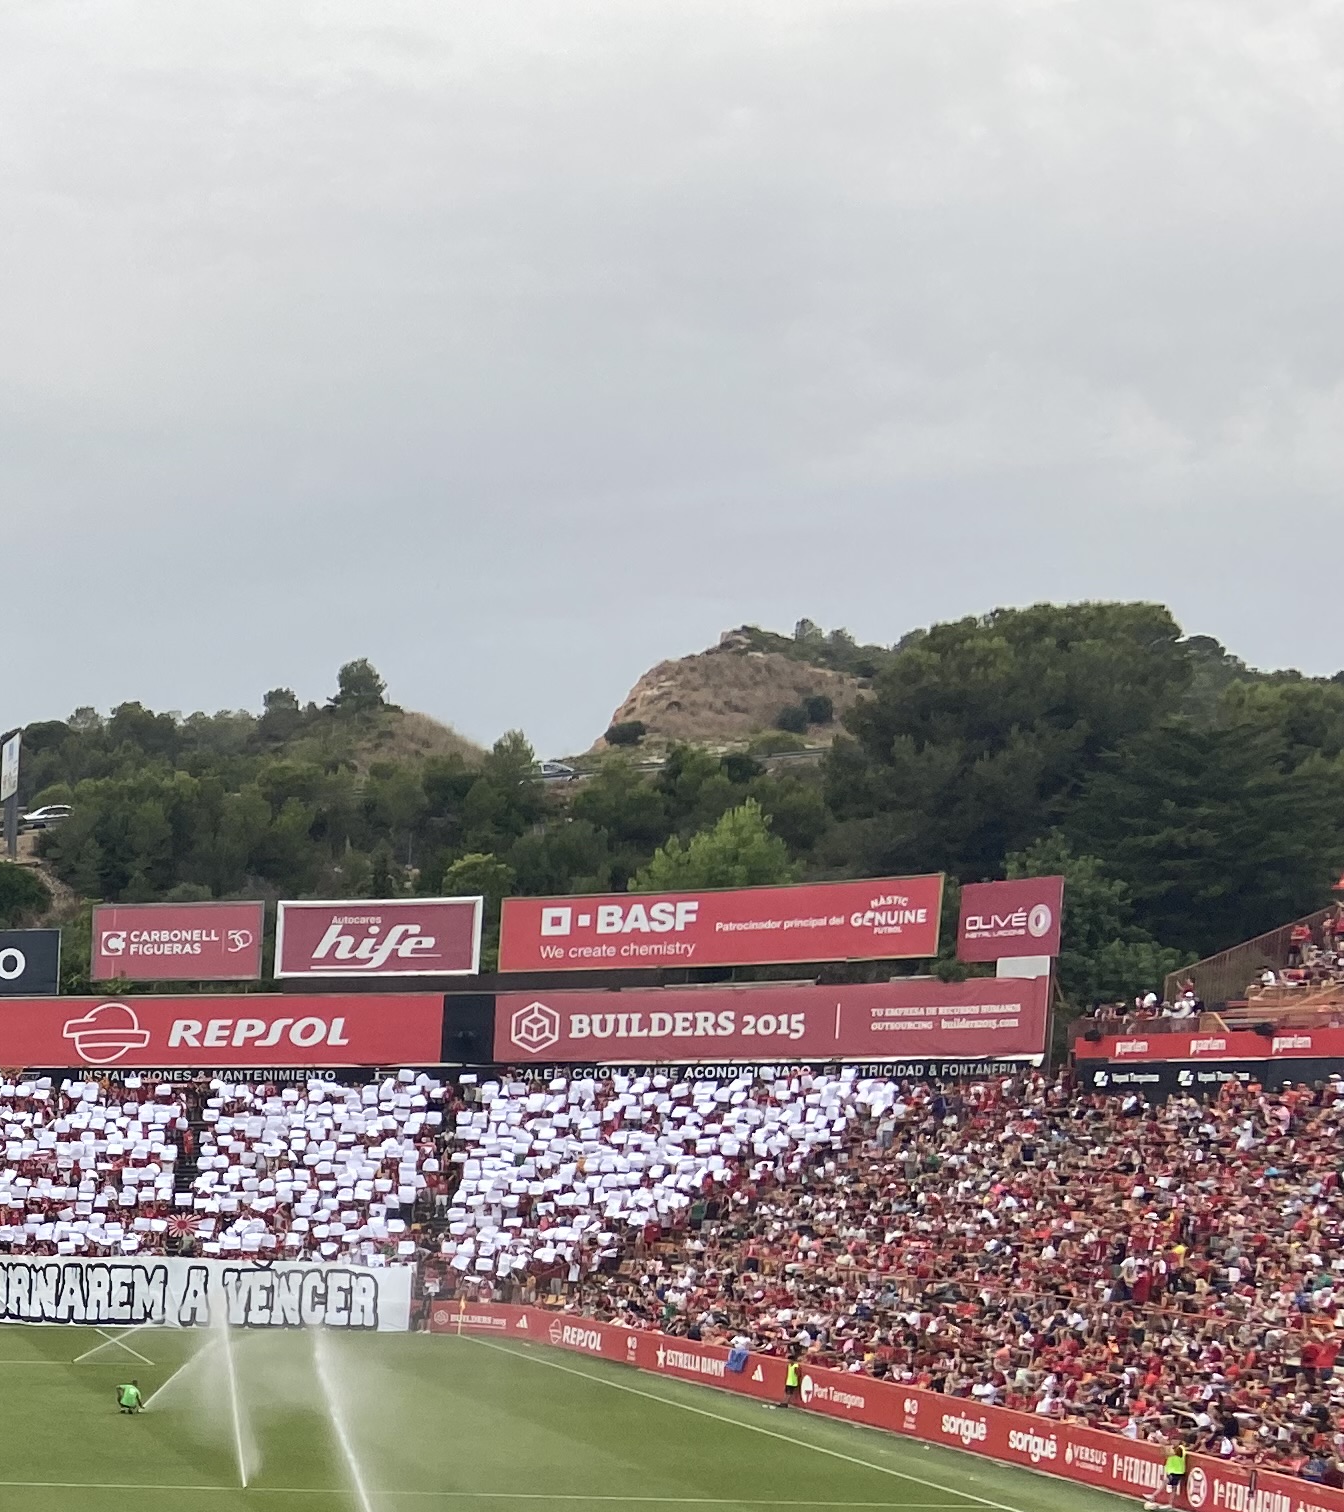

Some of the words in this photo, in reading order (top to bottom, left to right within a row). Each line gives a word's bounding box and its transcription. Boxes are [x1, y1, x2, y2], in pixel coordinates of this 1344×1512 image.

[331, 915, 382, 926] Autocares
[596, 901, 699, 934] BASF
[715, 919, 781, 932] Patrocinador
[783, 916, 827, 931] principal
[828, 915, 845, 927] del
[849, 908, 928, 927] GENUINE
[129, 928, 220, 943] CARBONELL
[129, 942, 202, 956] FIGUERAS
[310, 924, 443, 969] hife
[540, 945, 565, 959] We
[568, 945, 616, 959] create
[620, 941, 696, 958] chemistry
[167, 1017, 349, 1047] REPSOL
[569, 1011, 736, 1038] BUILDERS
[741, 1012, 805, 1039] 2015
[78, 1070, 193, 1082] INSTALACIONES
[213, 1070, 336, 1082] MANTENIMIENTO
[628, 1067, 637, 1079] &
[928, 1064, 937, 1077] &
[179, 1266, 209, 1327] A
[222, 1267, 379, 1330] VENCER
[562, 1325, 603, 1351] REPSOL
[666, 1349, 700, 1373] ESTRELLA
[700, 1353, 725, 1377] DAMM
[813, 1383, 829, 1401] Port
[829, 1386, 864, 1409] Tarragona
[1074, 1444, 1107, 1466] VERSUS
